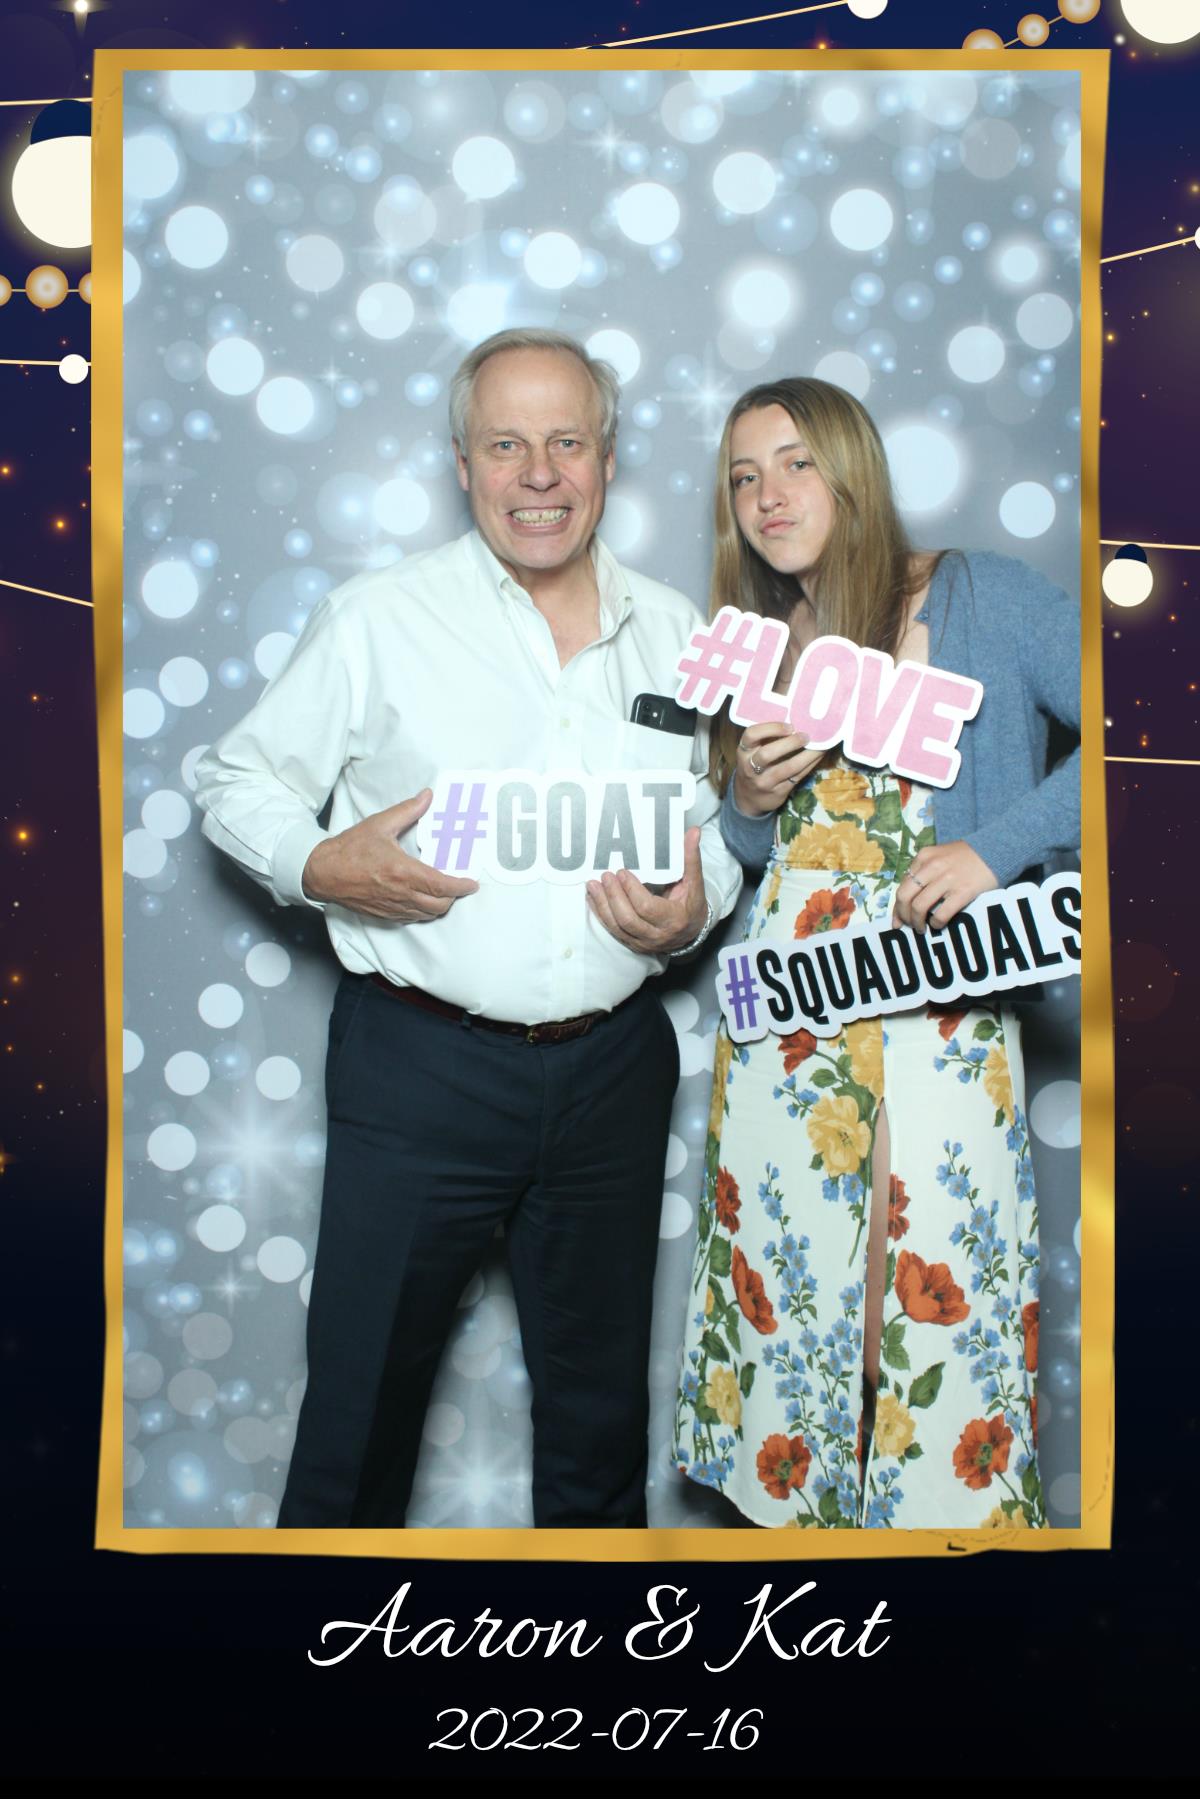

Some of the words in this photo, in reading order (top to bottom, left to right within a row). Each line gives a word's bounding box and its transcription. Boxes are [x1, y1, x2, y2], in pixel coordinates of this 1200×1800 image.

[677, 613, 975, 782] #LOVE
[431, 781, 682, 872] #GOAT
[725, 886, 1081, 1030] #SQUADGOALS
